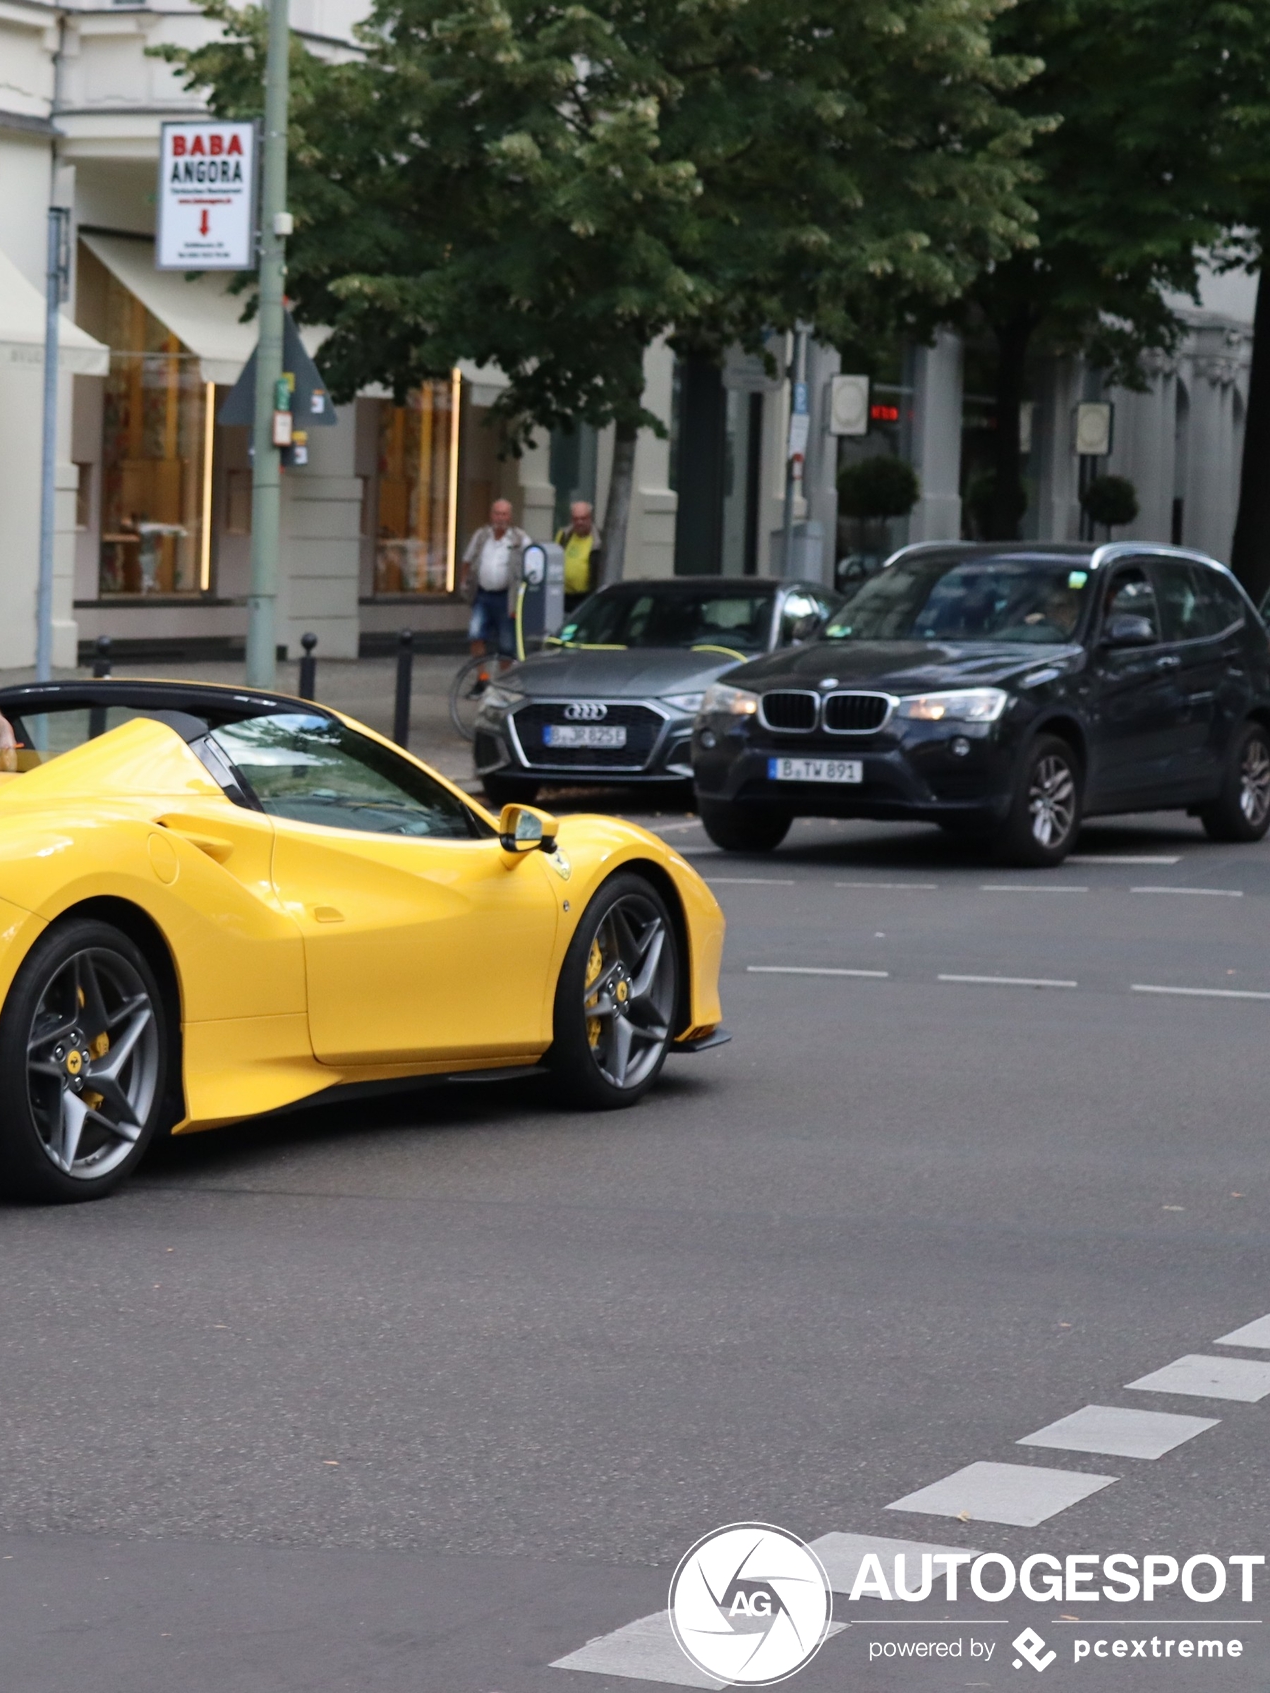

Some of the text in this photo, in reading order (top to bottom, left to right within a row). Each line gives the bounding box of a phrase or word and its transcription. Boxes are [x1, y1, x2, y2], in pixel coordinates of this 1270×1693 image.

[172, 134, 243, 157] BABA
[171, 160, 242, 183] ANGORA
[783, 759, 854, 779] B TW 891
